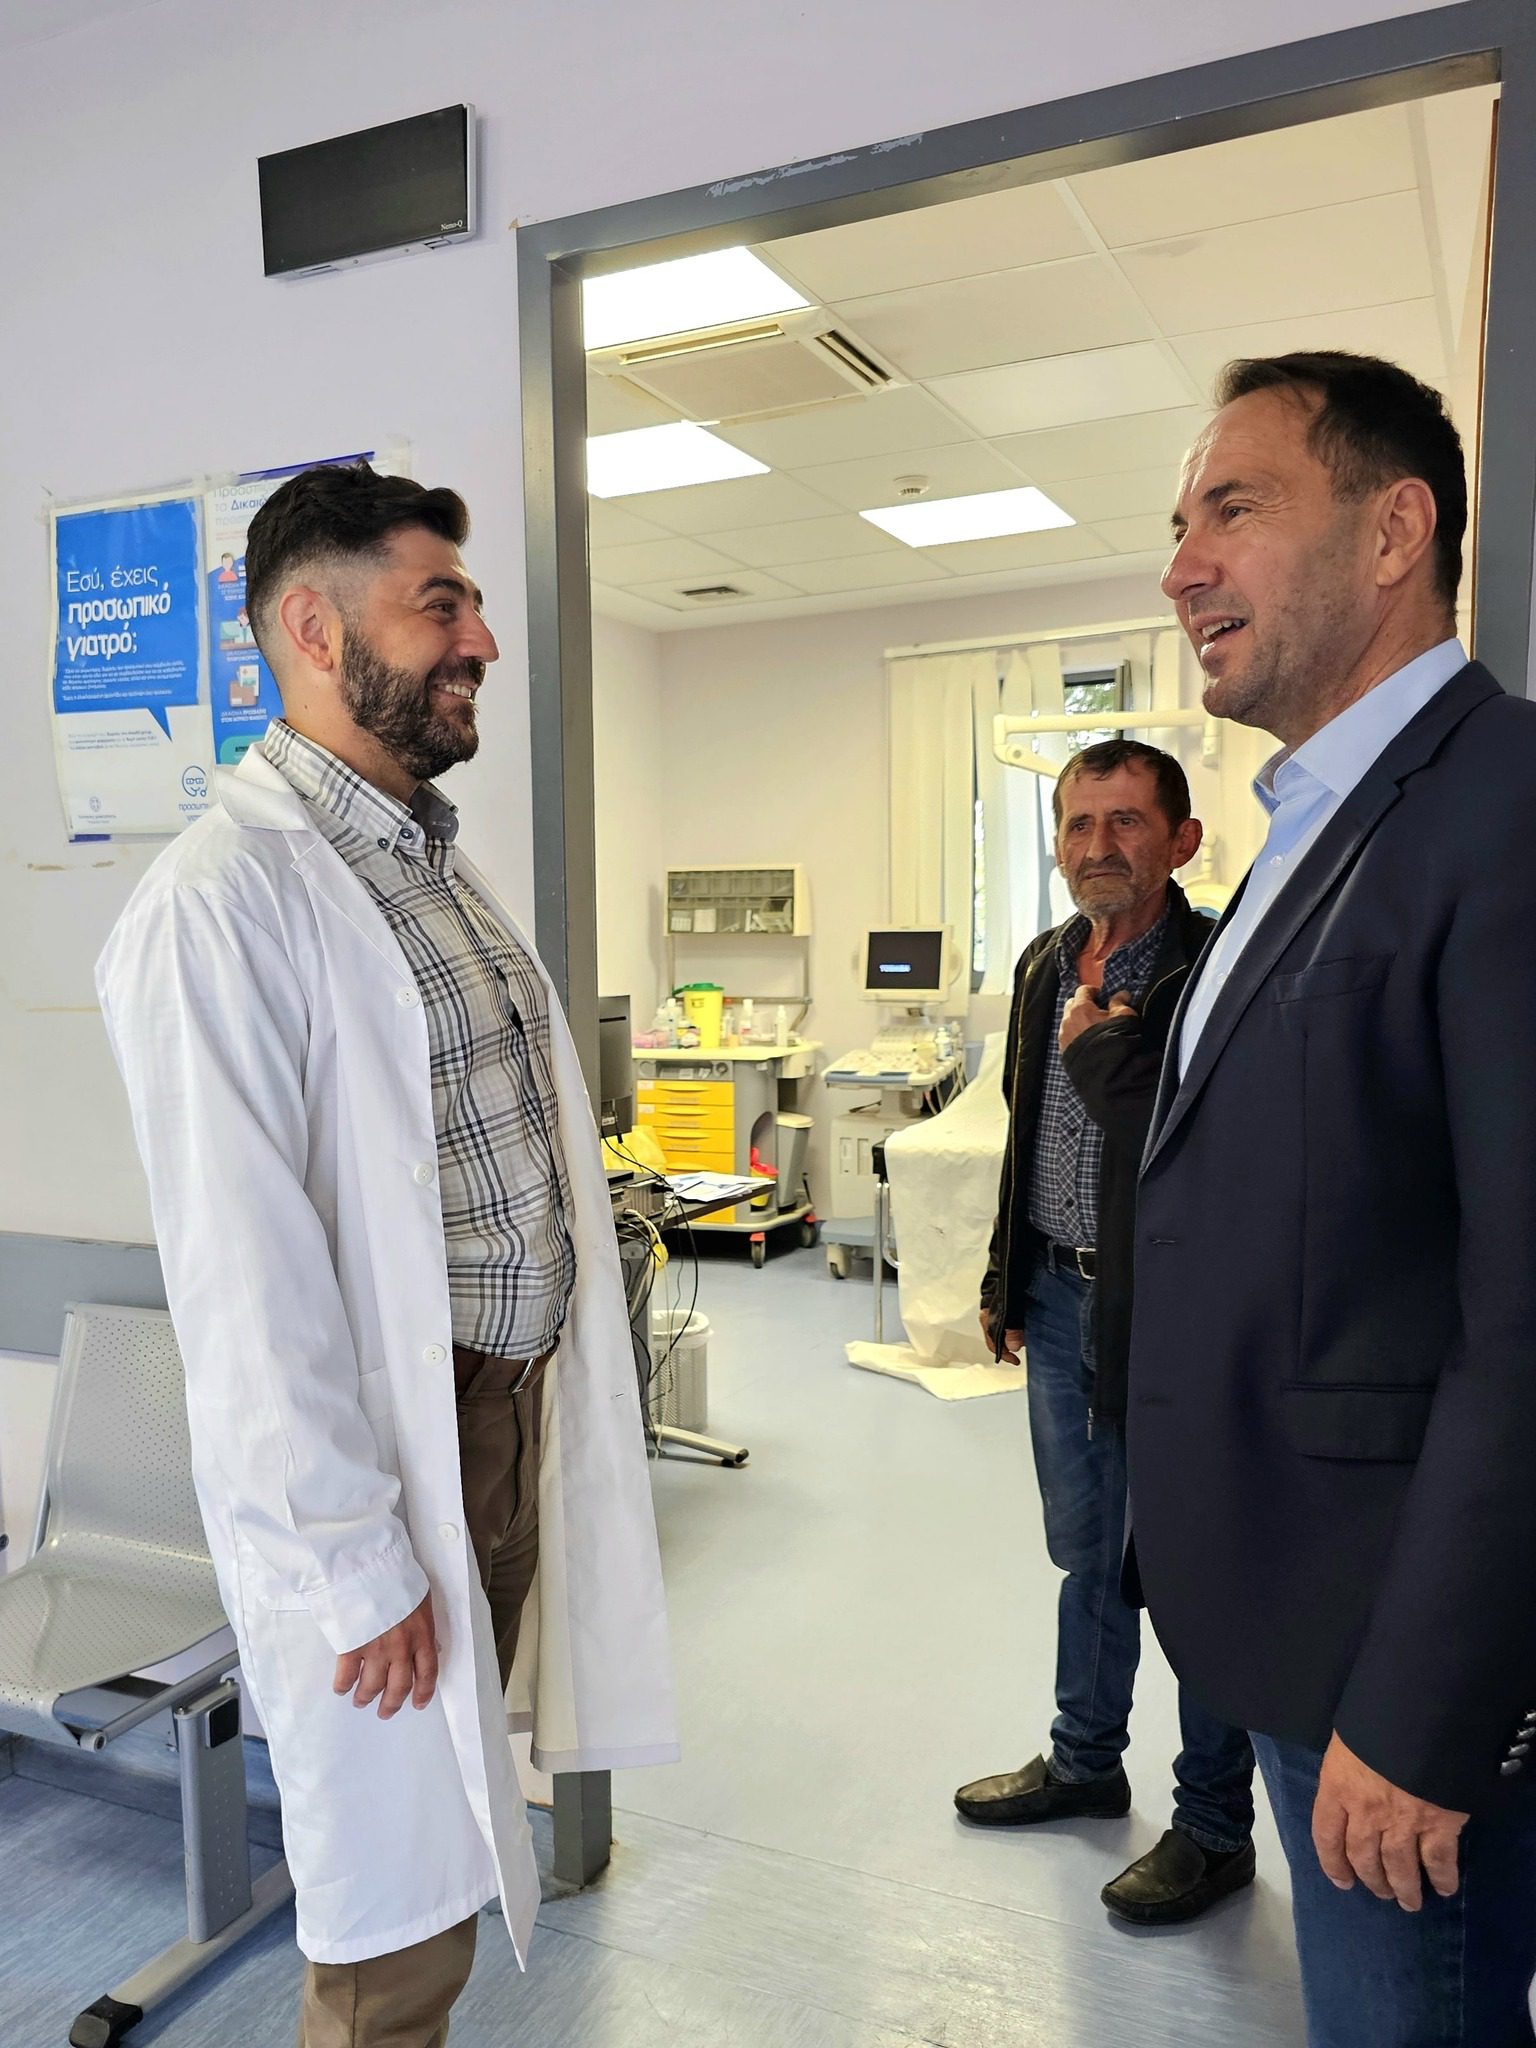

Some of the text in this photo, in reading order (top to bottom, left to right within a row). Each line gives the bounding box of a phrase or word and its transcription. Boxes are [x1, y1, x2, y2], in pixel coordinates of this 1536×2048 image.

[66, 564, 159, 593] Εσύ, έχεις
[67, 581, 171, 630] προσωπικό
[66, 621, 138, 662] γιατρό;
